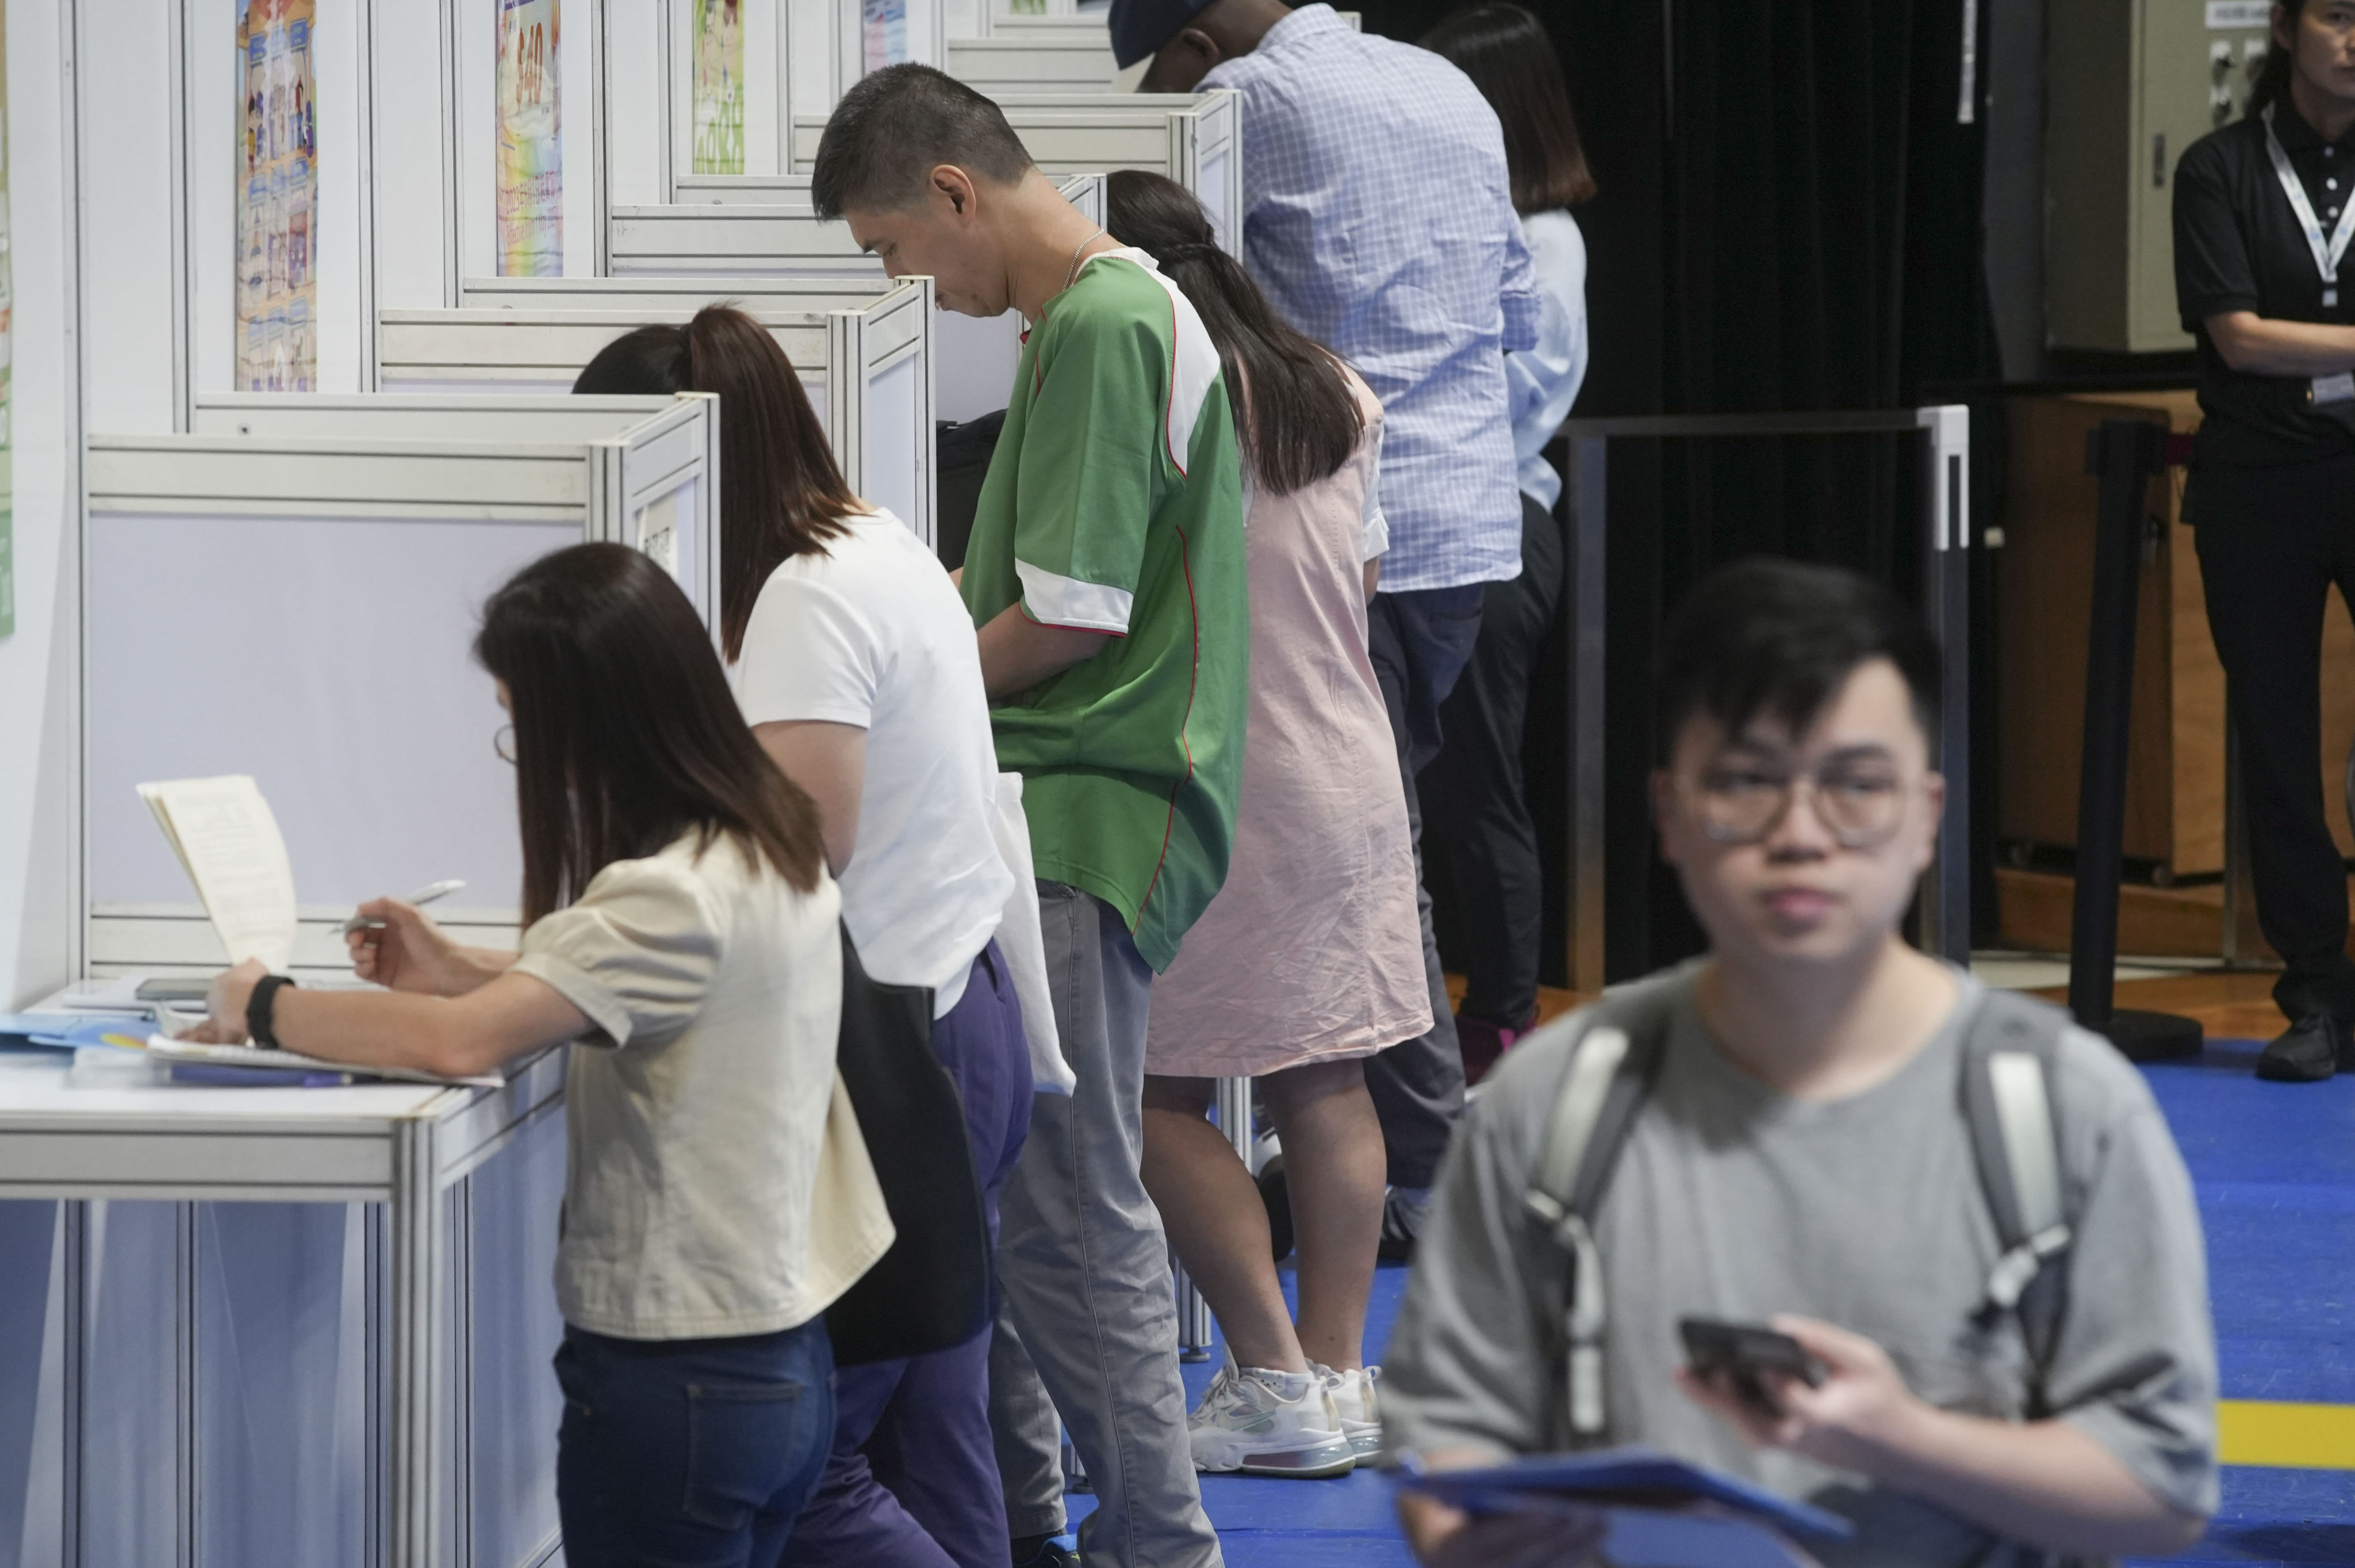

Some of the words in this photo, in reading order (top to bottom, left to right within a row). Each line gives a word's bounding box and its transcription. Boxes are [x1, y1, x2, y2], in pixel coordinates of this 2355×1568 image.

[516, 22, 542, 112] $40
[507, 222, 524, 246] Effective
[538, 210, 547, 238] May
